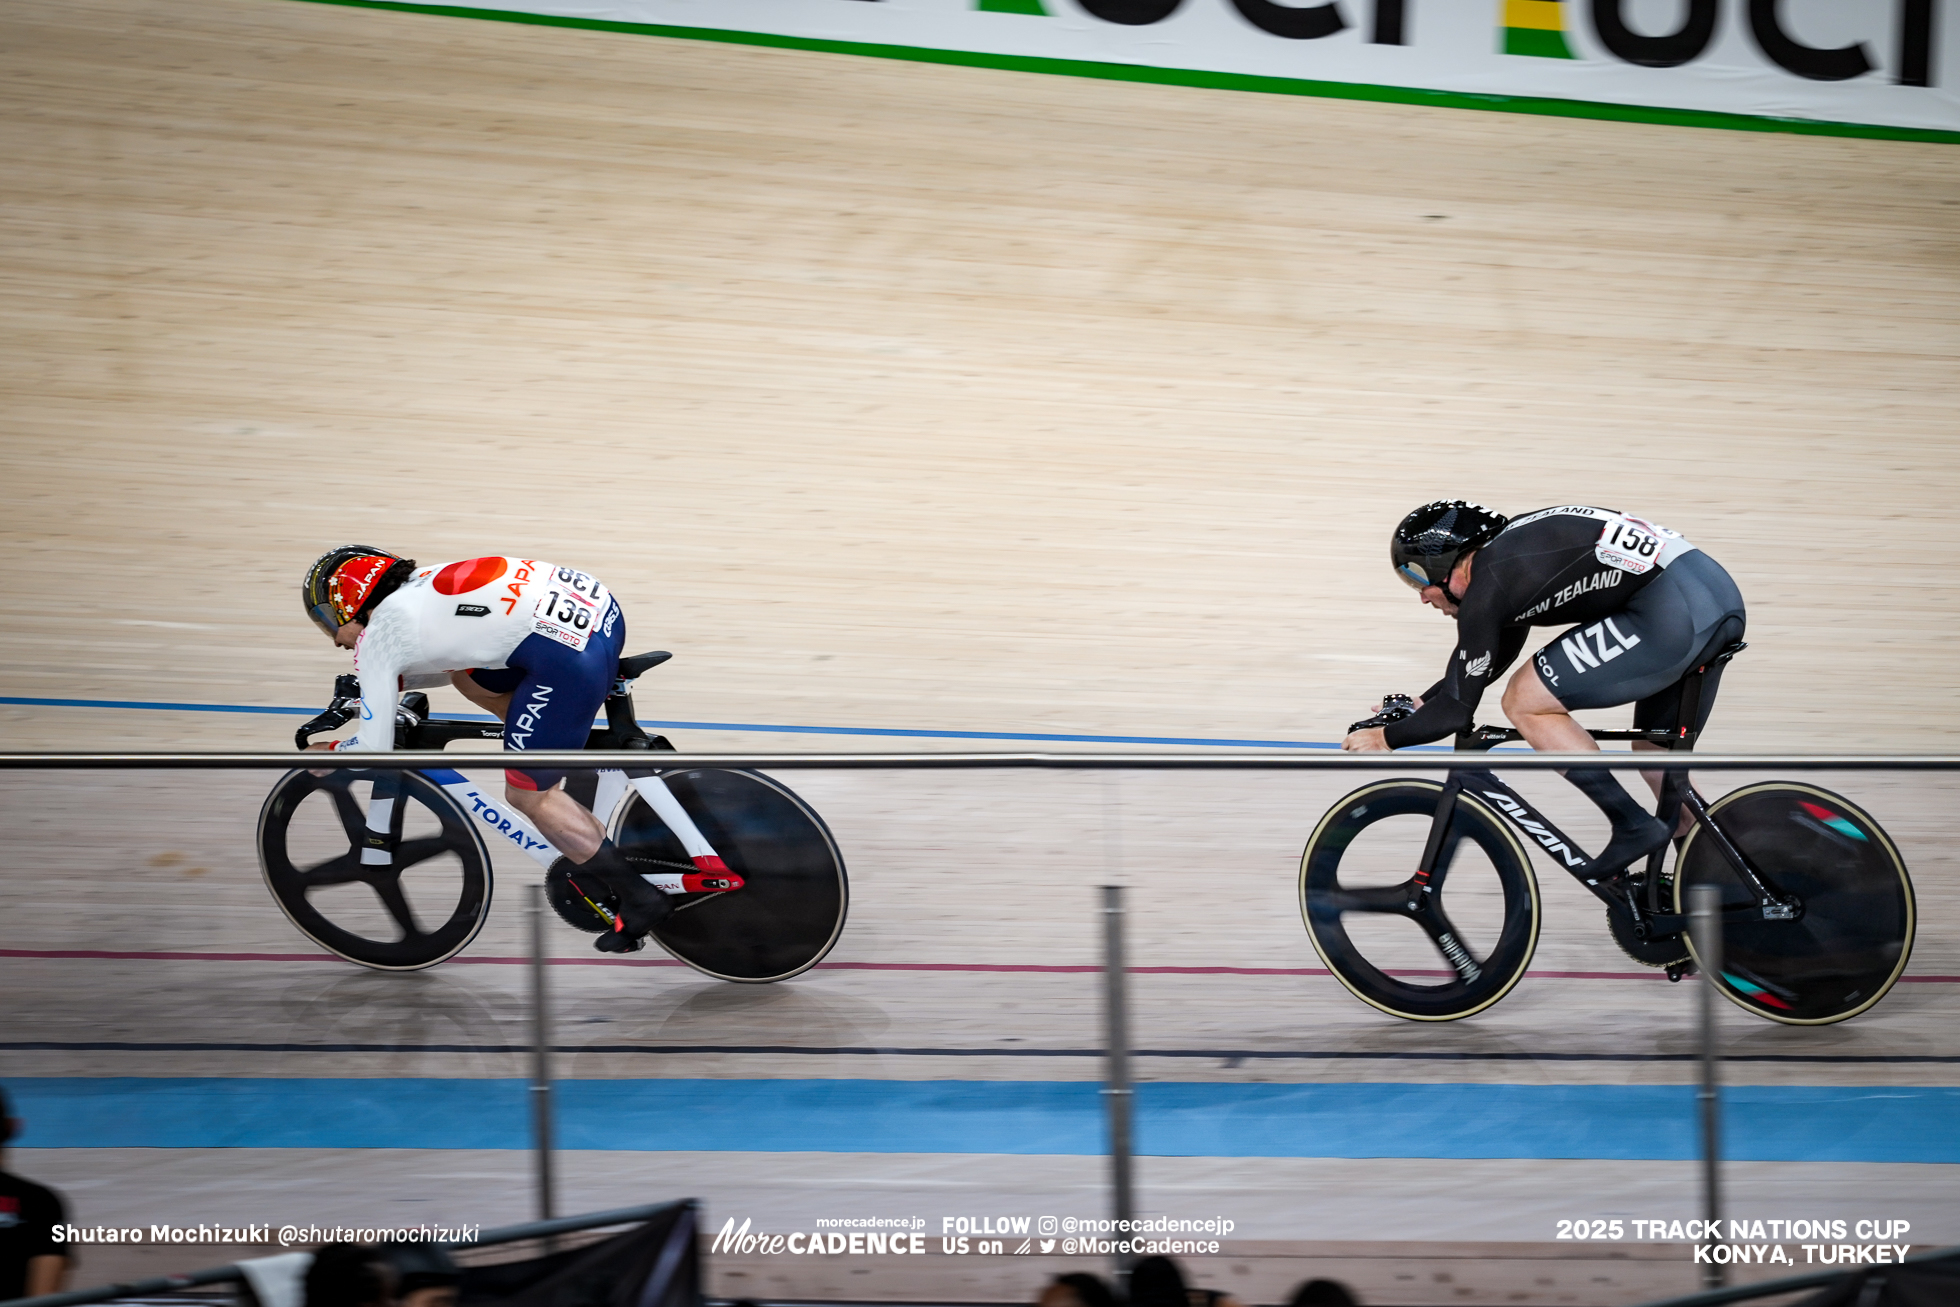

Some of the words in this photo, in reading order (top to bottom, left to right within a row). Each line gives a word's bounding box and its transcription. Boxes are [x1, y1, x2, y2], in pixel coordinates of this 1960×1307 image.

[1609, 523, 1660, 557] 158
[357, 559, 386, 600] JAPAN
[1514, 598, 1551, 622] NEW
[1554, 569, 1623, 608] ZEALAND
[545, 591, 592, 630] 138
[1560, 616, 1641, 674] NZL
